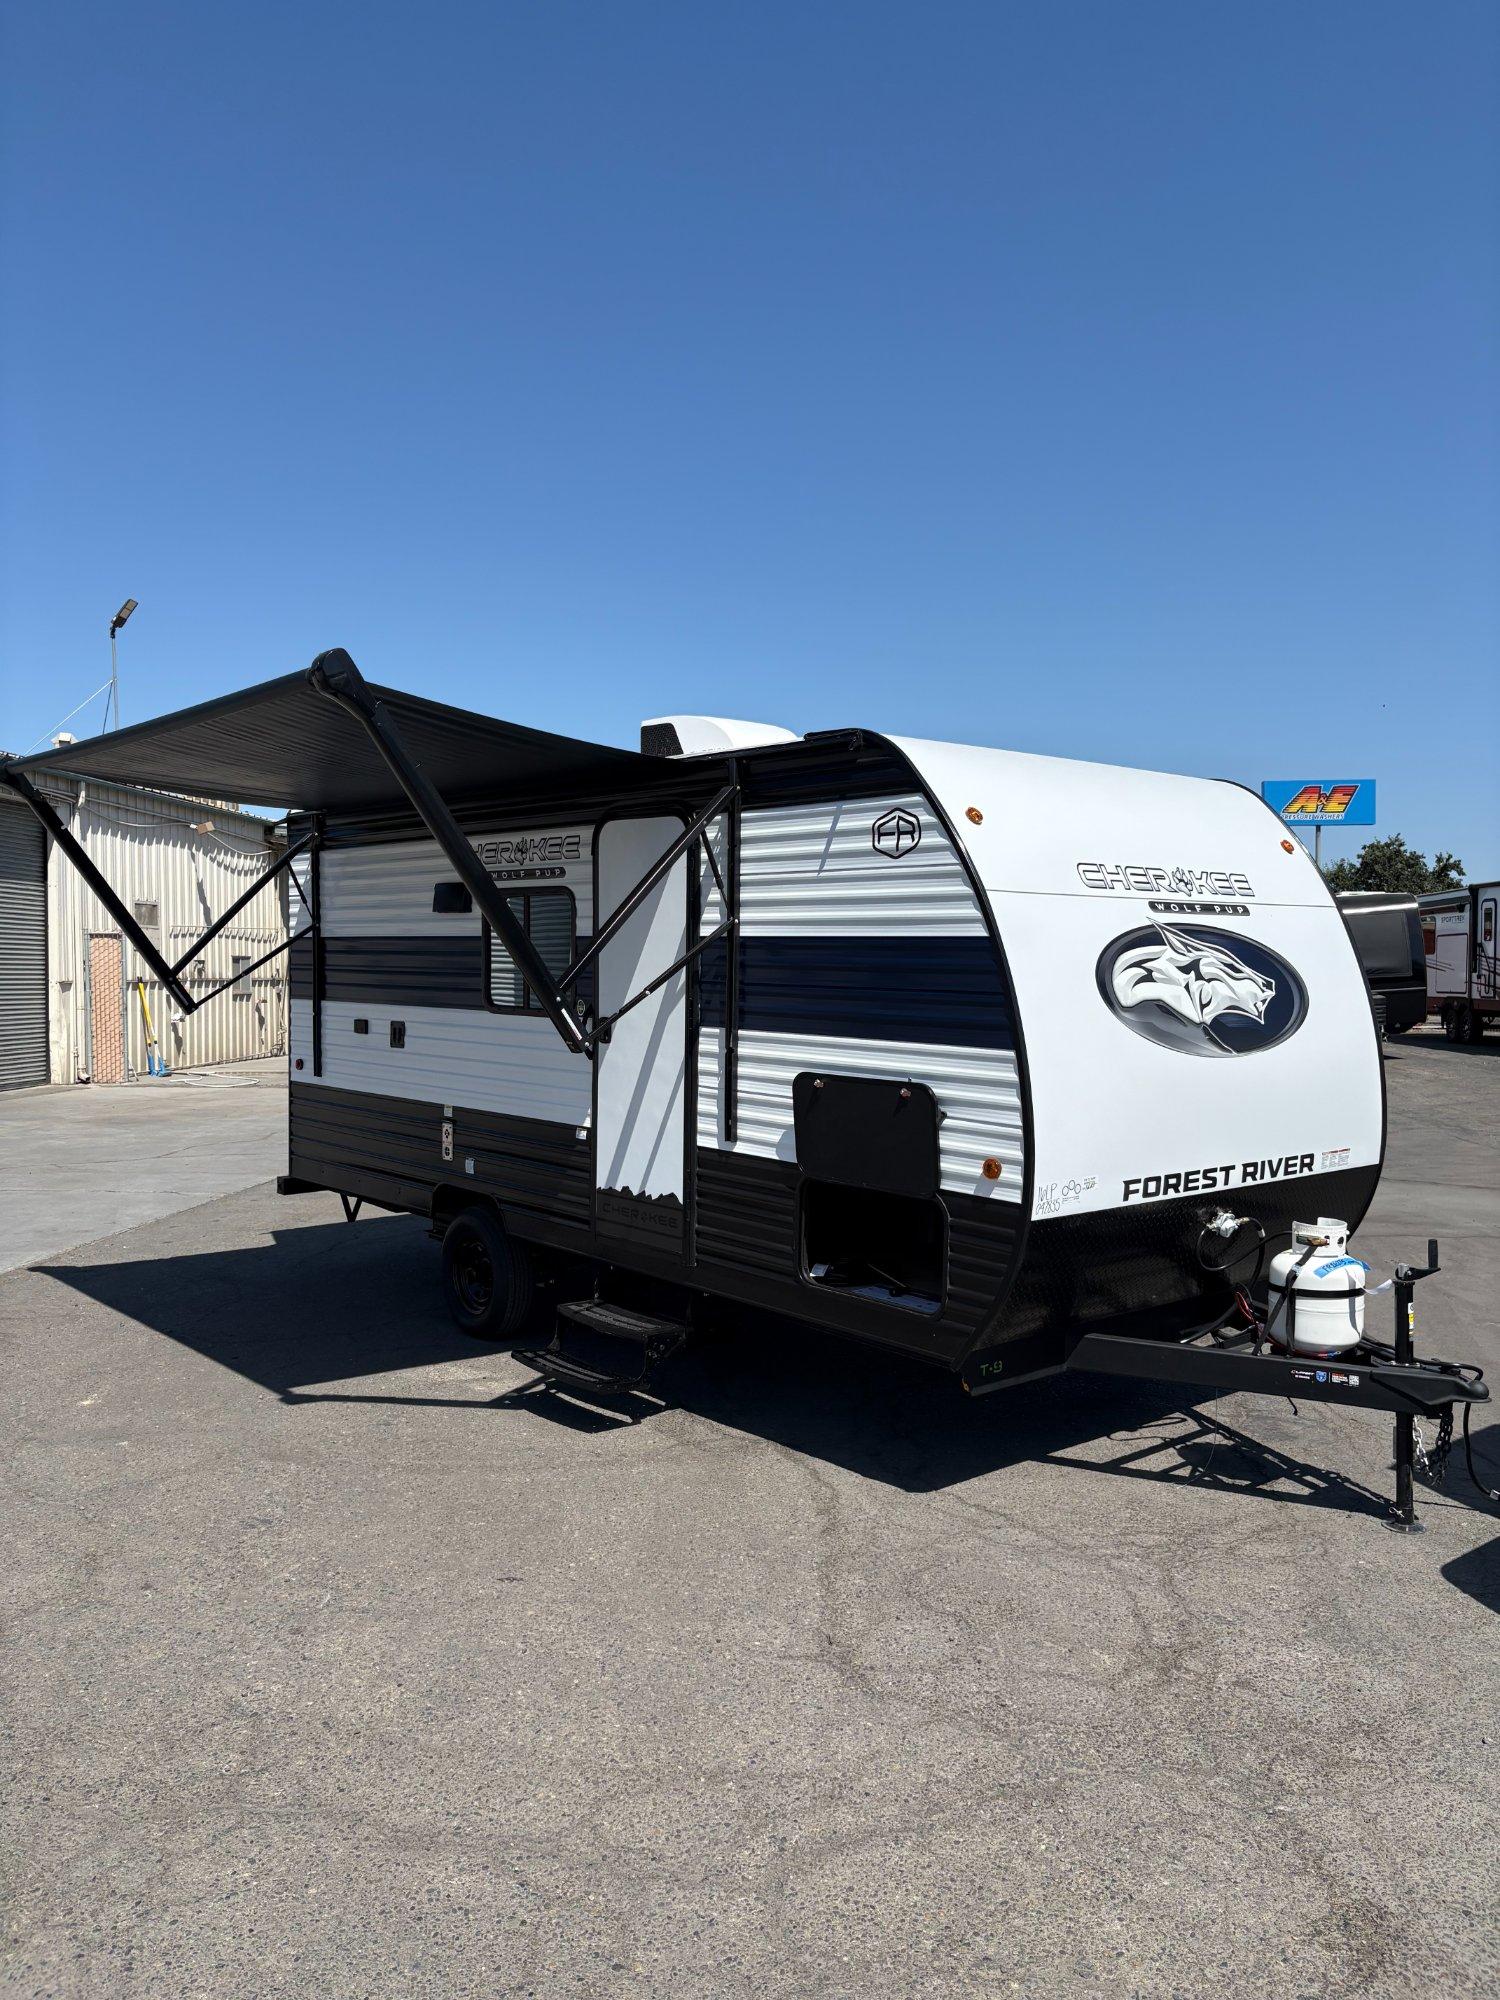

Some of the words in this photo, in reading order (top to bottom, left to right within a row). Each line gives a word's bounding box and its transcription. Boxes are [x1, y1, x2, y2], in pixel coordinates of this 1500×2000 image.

[1282, 784, 1360, 814] A&E
[491, 869, 525, 880] WOLF
[535, 867, 561, 878] PUP
[1076, 862, 1256, 898] CHEROKEE
[1154, 902, 1202, 914] WOLF
[1215, 904, 1244, 915] PUP
[1122, 1164, 1236, 1202] FOREST
[1241, 1152, 1315, 1183] RIVER
[602, 1202, 679, 1230] CHEROKEE
